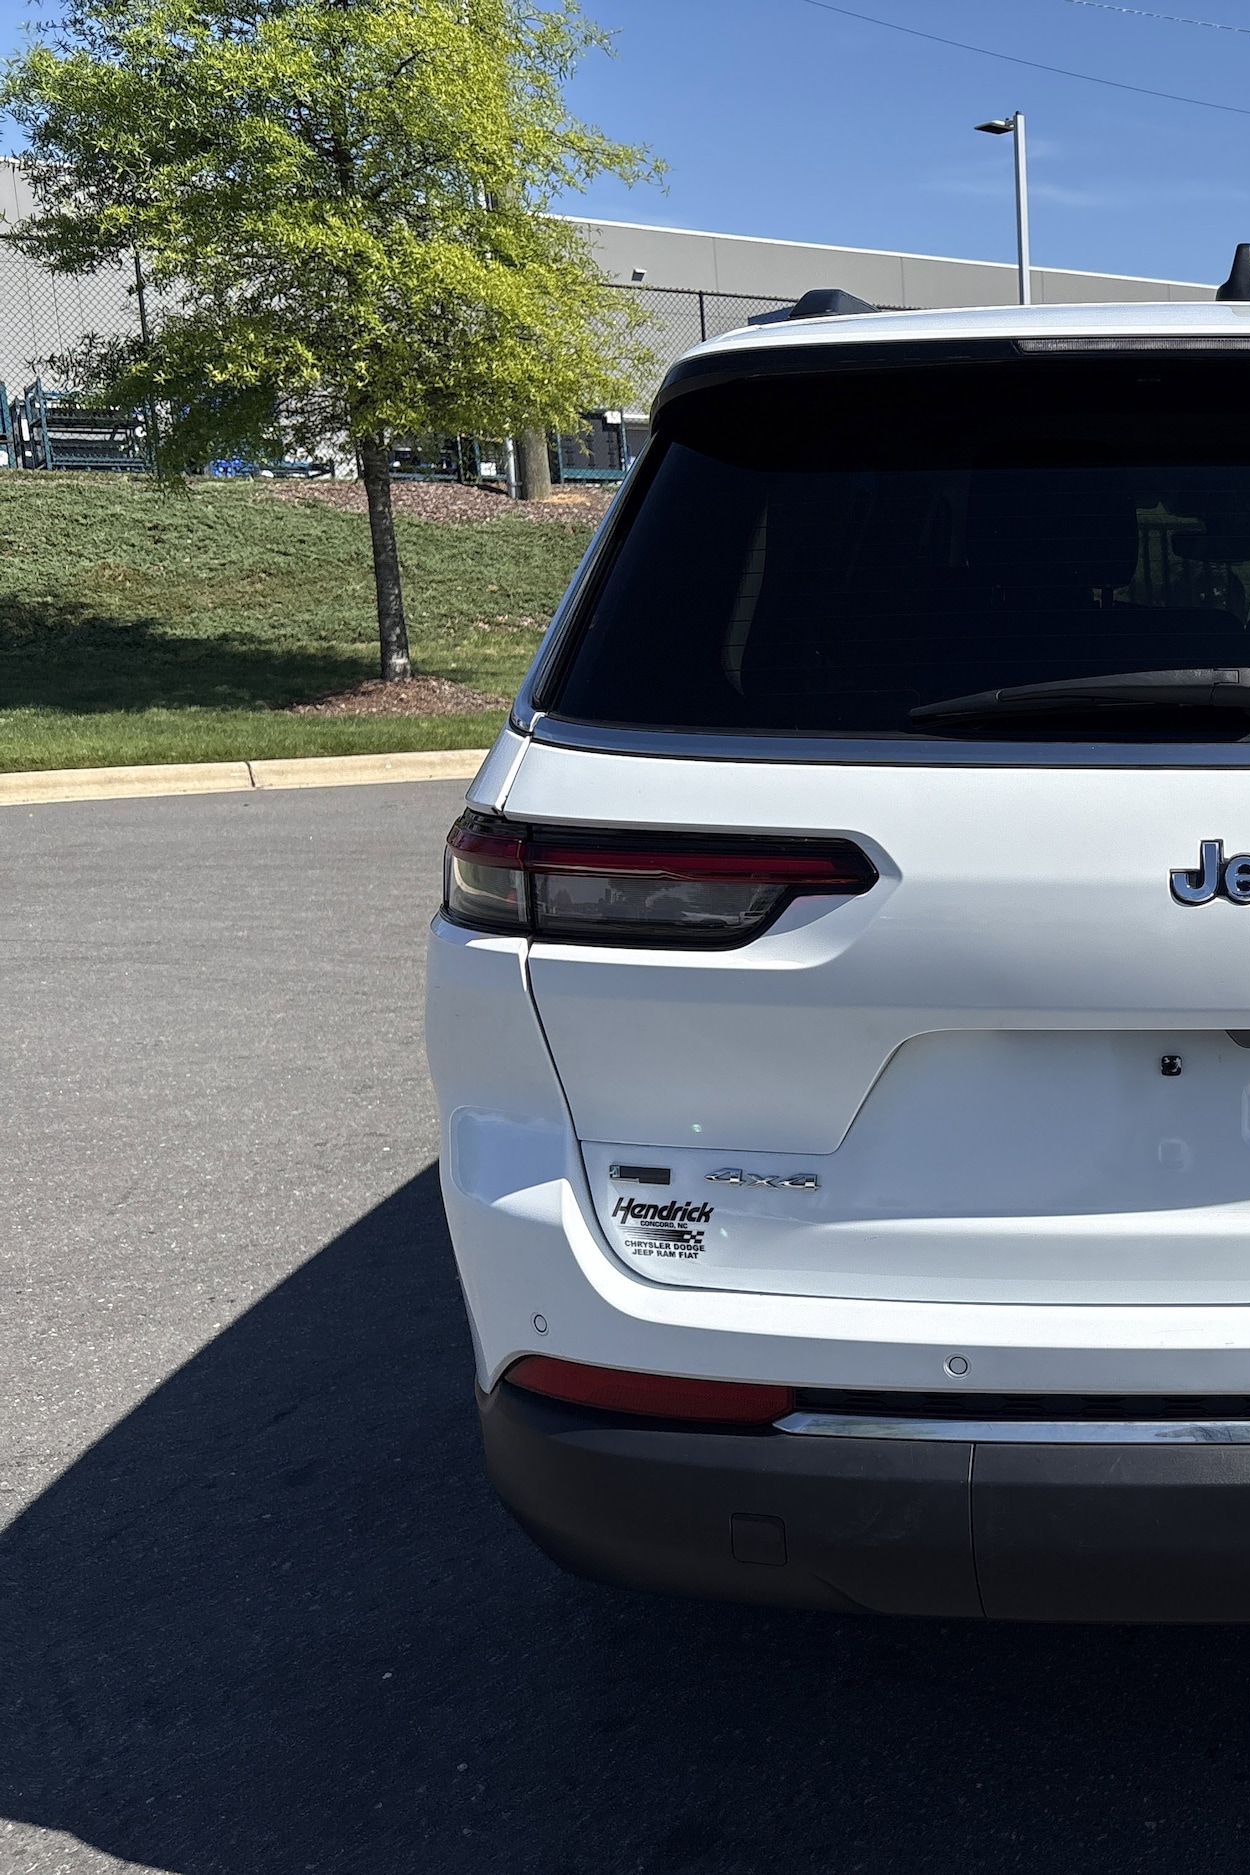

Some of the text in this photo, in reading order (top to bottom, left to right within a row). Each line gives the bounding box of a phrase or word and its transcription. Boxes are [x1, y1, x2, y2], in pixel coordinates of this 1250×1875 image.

[704, 1167, 822, 1192] 4x4
[611, 1196, 715, 1225] Hendrick
[640, 1220, 677, 1229] CONCORD,
[624, 1240, 705, 1252] CHRYSLER DODGE
[632, 1248, 654, 1256] JEEP
[656, 1249, 677, 1258] RAM
